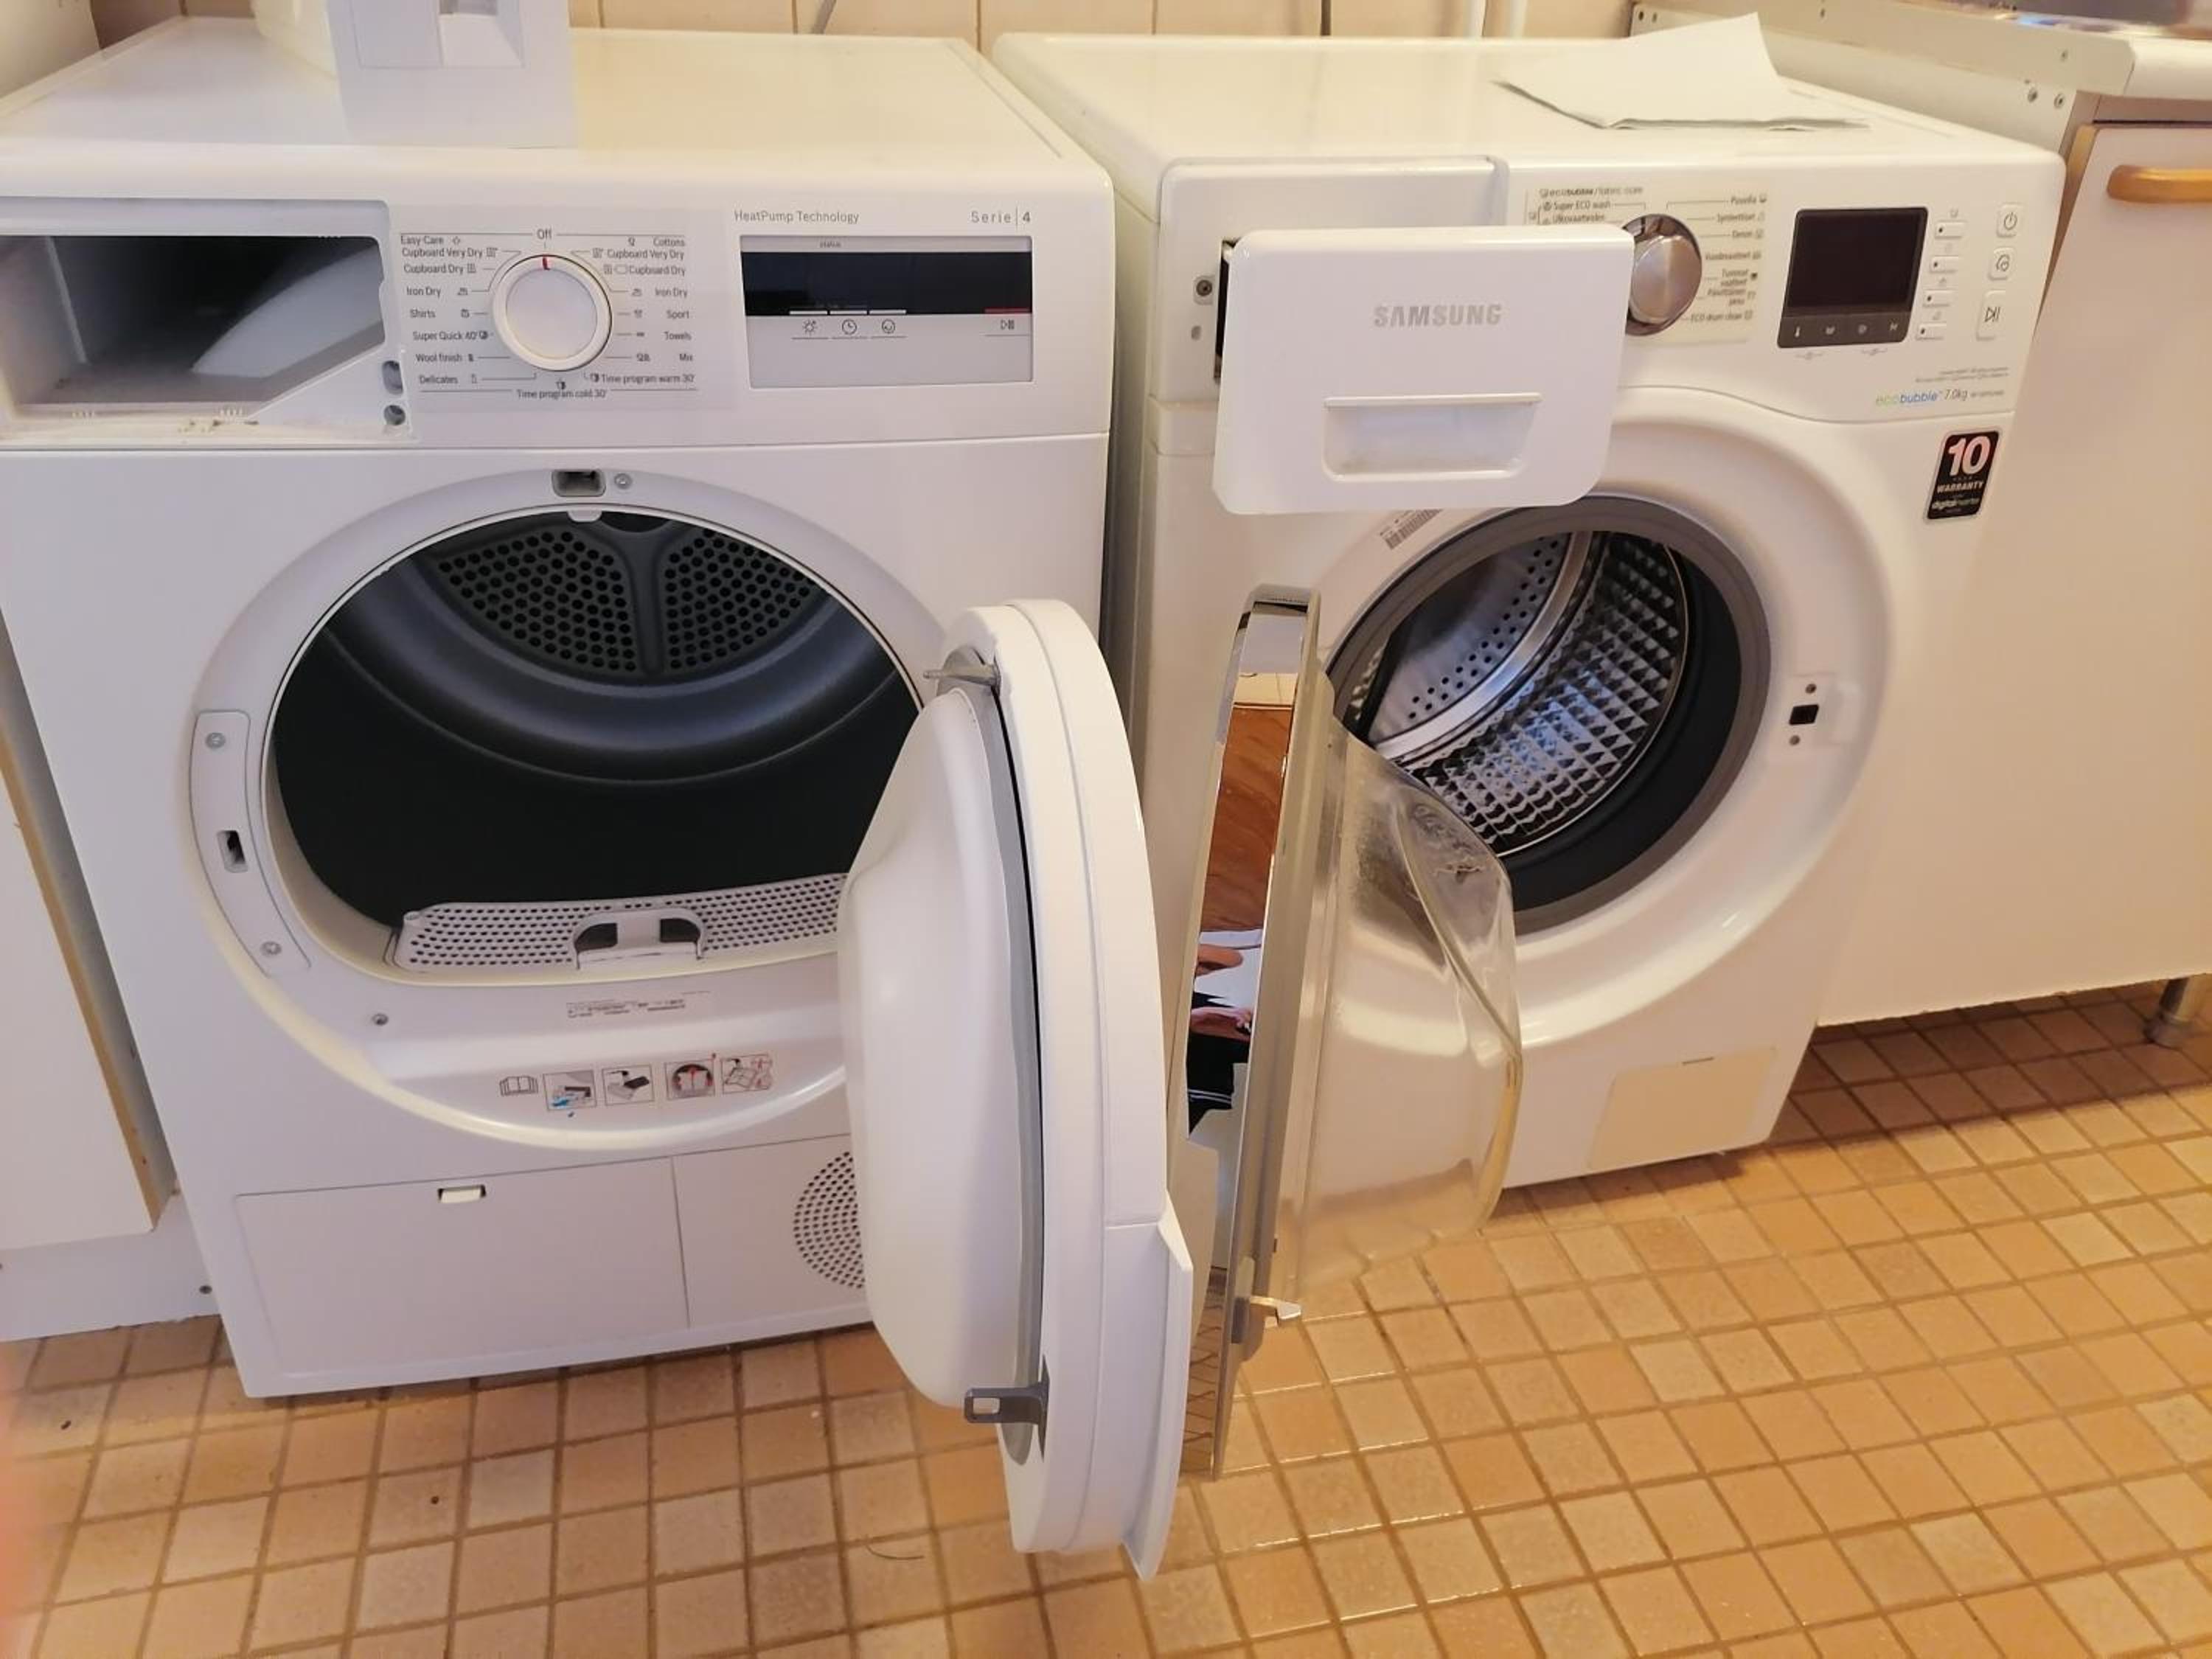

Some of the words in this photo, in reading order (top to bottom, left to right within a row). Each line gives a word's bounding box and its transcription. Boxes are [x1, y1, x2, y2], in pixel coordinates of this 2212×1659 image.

[1575, 200, 1591, 209] ECO
[734, 211, 793, 223] HeatPump
[796, 211, 860, 224] Technology
[971, 210, 1012, 223] Serie
[1022, 211, 1031, 223] 4
[537, 227, 552, 240] Off
[400, 235, 421, 246] Easy
[423, 236, 444, 245] Care
[653, 237, 686, 247] Cottons
[402, 248, 445, 258] Cupboard
[447, 248, 465, 258] Very
[467, 248, 483, 258] Dry
[607, 249, 648, 260] Cupboard
[649, 249, 668, 260] Very
[669, 249, 684, 260] Dry
[403, 263, 447, 274] Cupboard
[448, 264, 464, 275] Dry
[629, 265, 669, 276] Cupboard
[671, 265, 686, 276] Dry
[406, 287, 424, 296] Iron
[425, 287, 441, 298] Dry
[655, 288, 672, 296] Iron
[673, 288, 688, 298] Dry
[410, 308, 437, 319] Shirts
[666, 310, 690, 320] Sport
[1374, 303, 1502, 327] SAMSUNG
[413, 331, 437, 341] Super
[439, 331, 462, 341] Quick
[664, 332, 692, 341] Towels
[415, 353, 437, 362] Wool
[439, 353, 462, 362] finish
[420, 375, 459, 384] Delicates
[601, 374, 622, 383] Time
[623, 375, 657, 385] program
[517, 389, 538, 398] Time
[539, 390, 572, 400] program
[573, 389, 594, 398] cold
[1948, 435, 1991, 476] 10
[1936, 480, 1985, 494] WARRANTY
